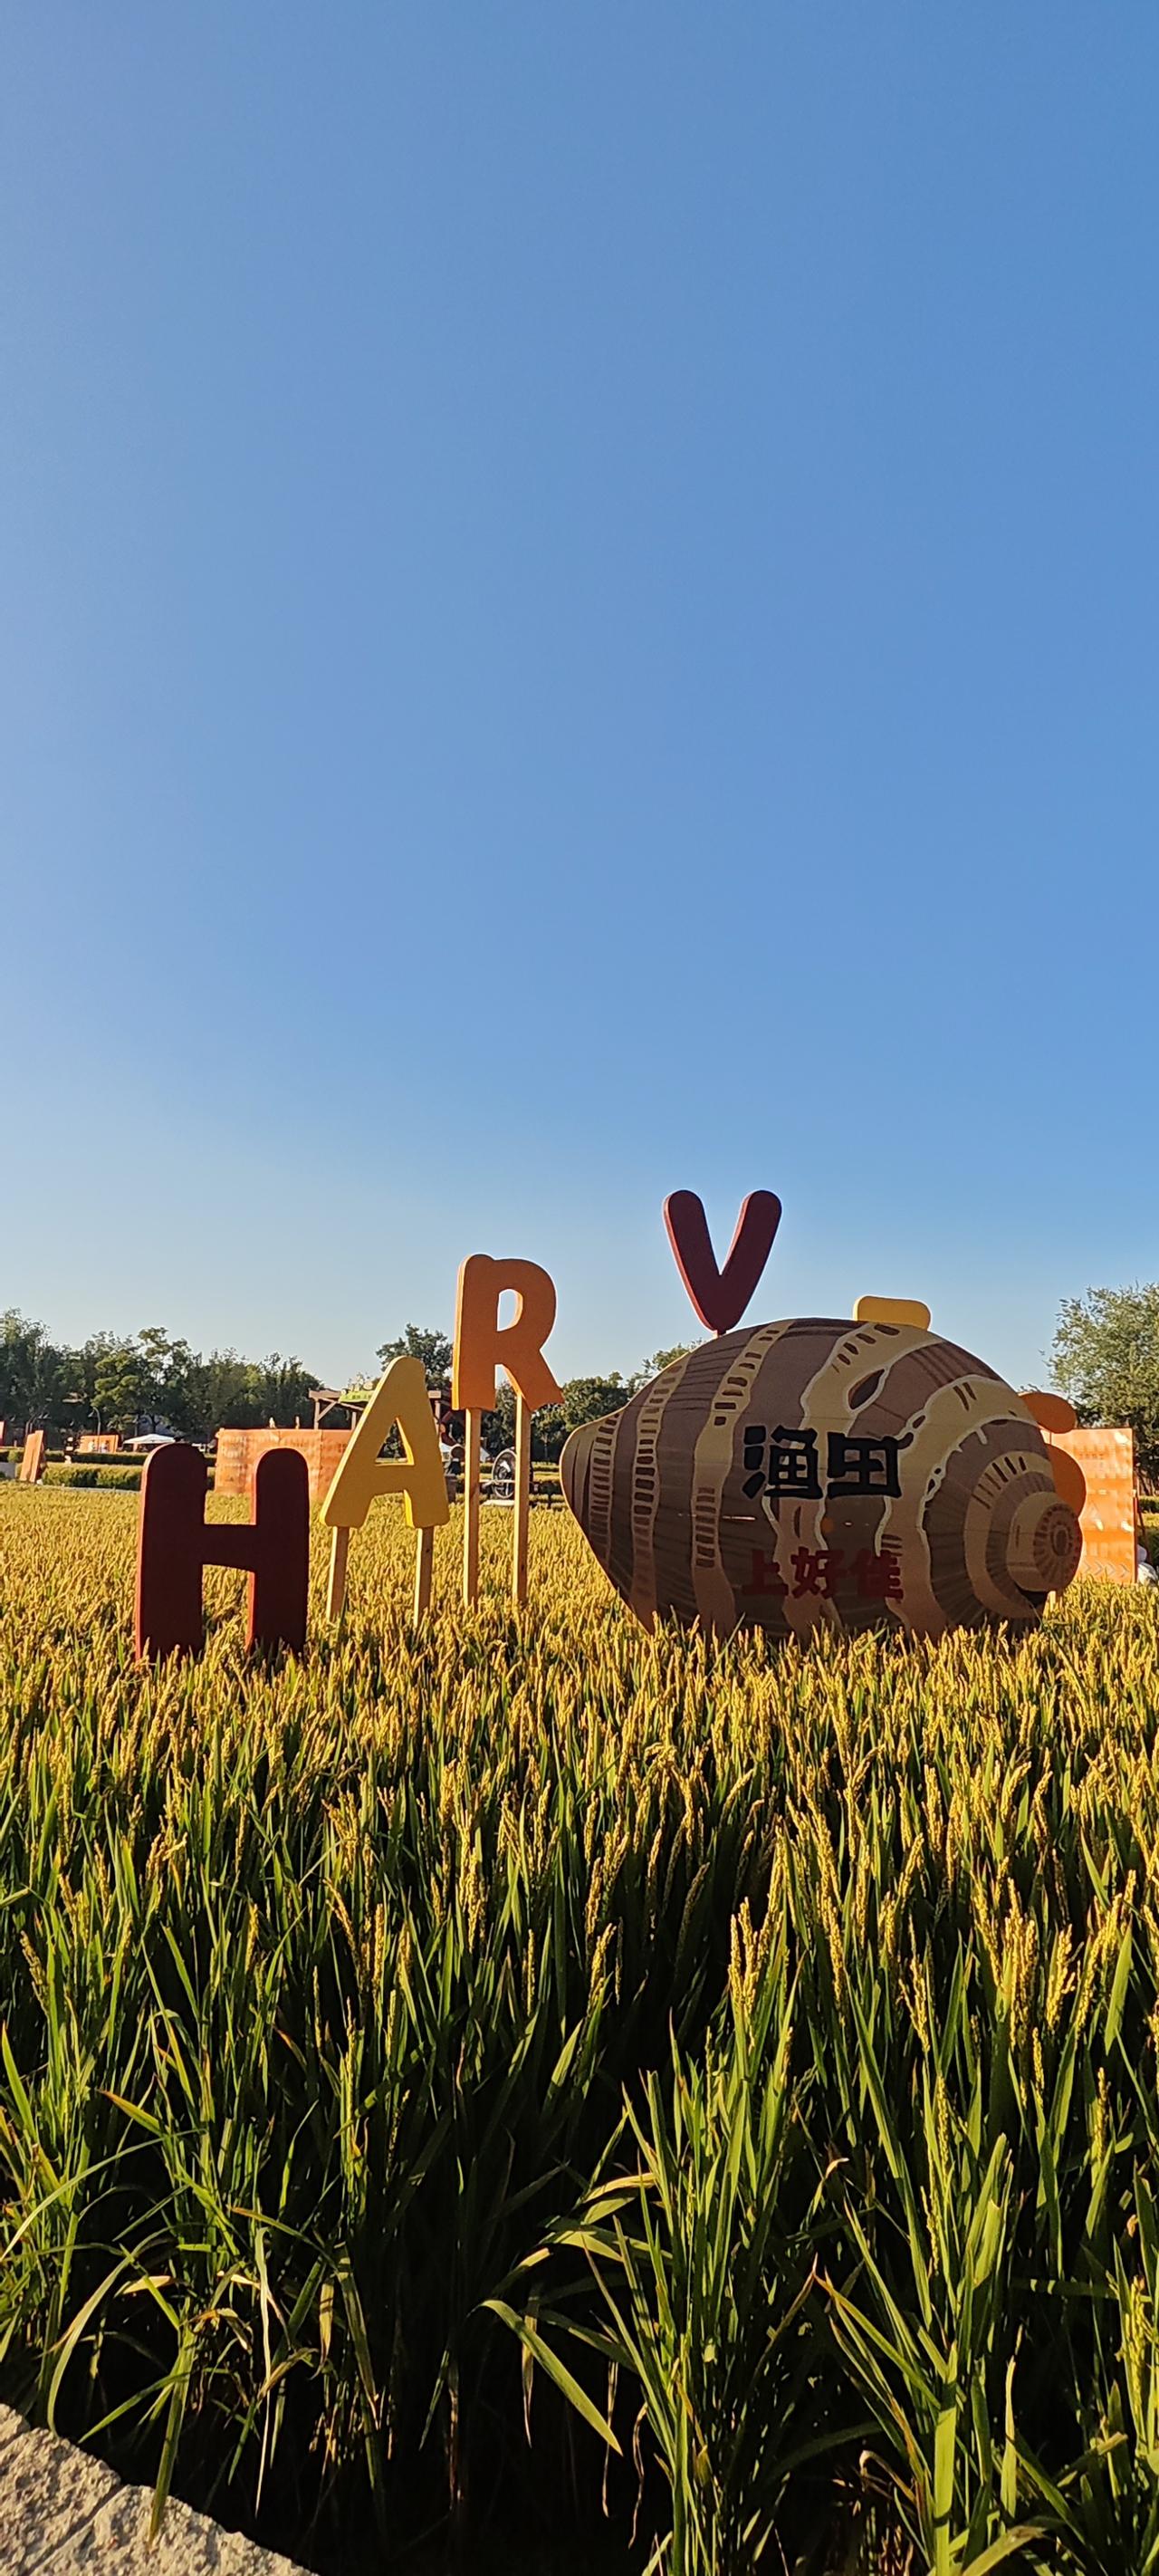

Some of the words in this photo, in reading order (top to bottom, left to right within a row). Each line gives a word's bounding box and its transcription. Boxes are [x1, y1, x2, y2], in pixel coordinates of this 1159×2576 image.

[742, 1425, 903, 1499] 渔田
[742, 1546, 904, 1600] 上好佳
